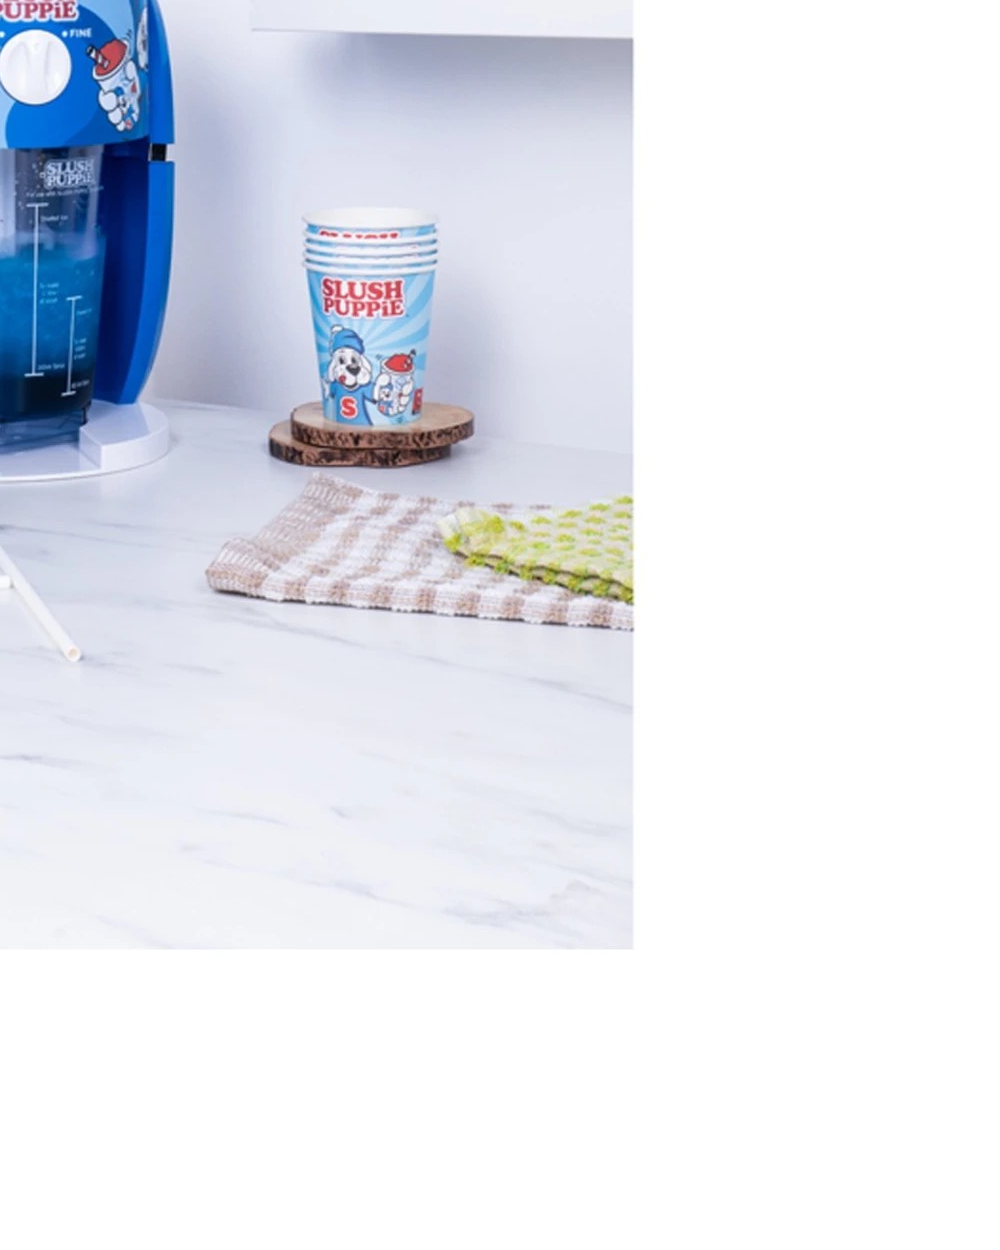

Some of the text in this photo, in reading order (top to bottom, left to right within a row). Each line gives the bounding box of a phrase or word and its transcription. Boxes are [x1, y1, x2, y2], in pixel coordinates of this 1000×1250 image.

[69, 28, 92, 38] FINE
[46, 159, 94, 175] SLUSH
[322, 279, 403, 300] SLUSH
[341, 398, 357, 418] S
